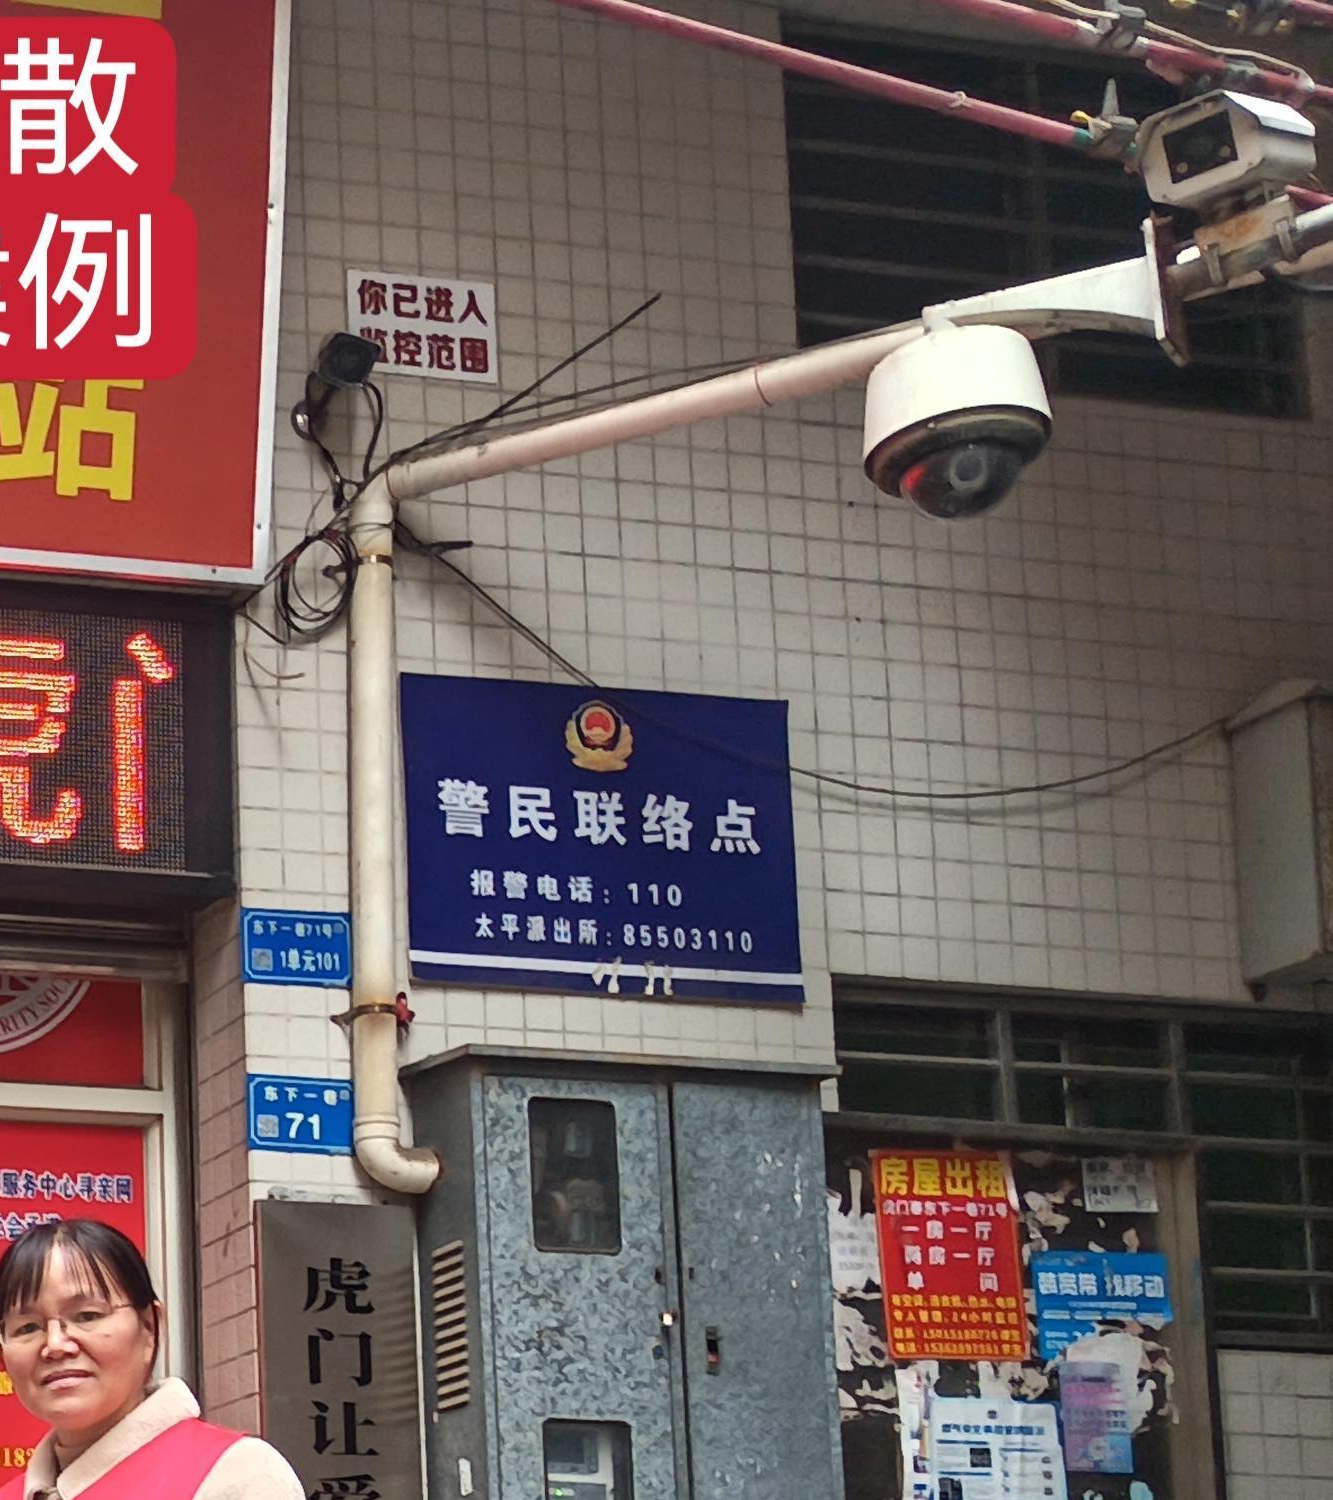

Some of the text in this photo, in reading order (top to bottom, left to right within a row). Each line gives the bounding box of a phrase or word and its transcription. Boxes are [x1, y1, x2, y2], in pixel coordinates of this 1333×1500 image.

[357, 279, 488, 327] 你已进入
[437, 779, 762, 854] 警民联络点
[280, 948, 340, 972] 1单元101
[285, 1112, 321, 1140] 71
[880, 1158, 1008, 1198] 房屋出租
